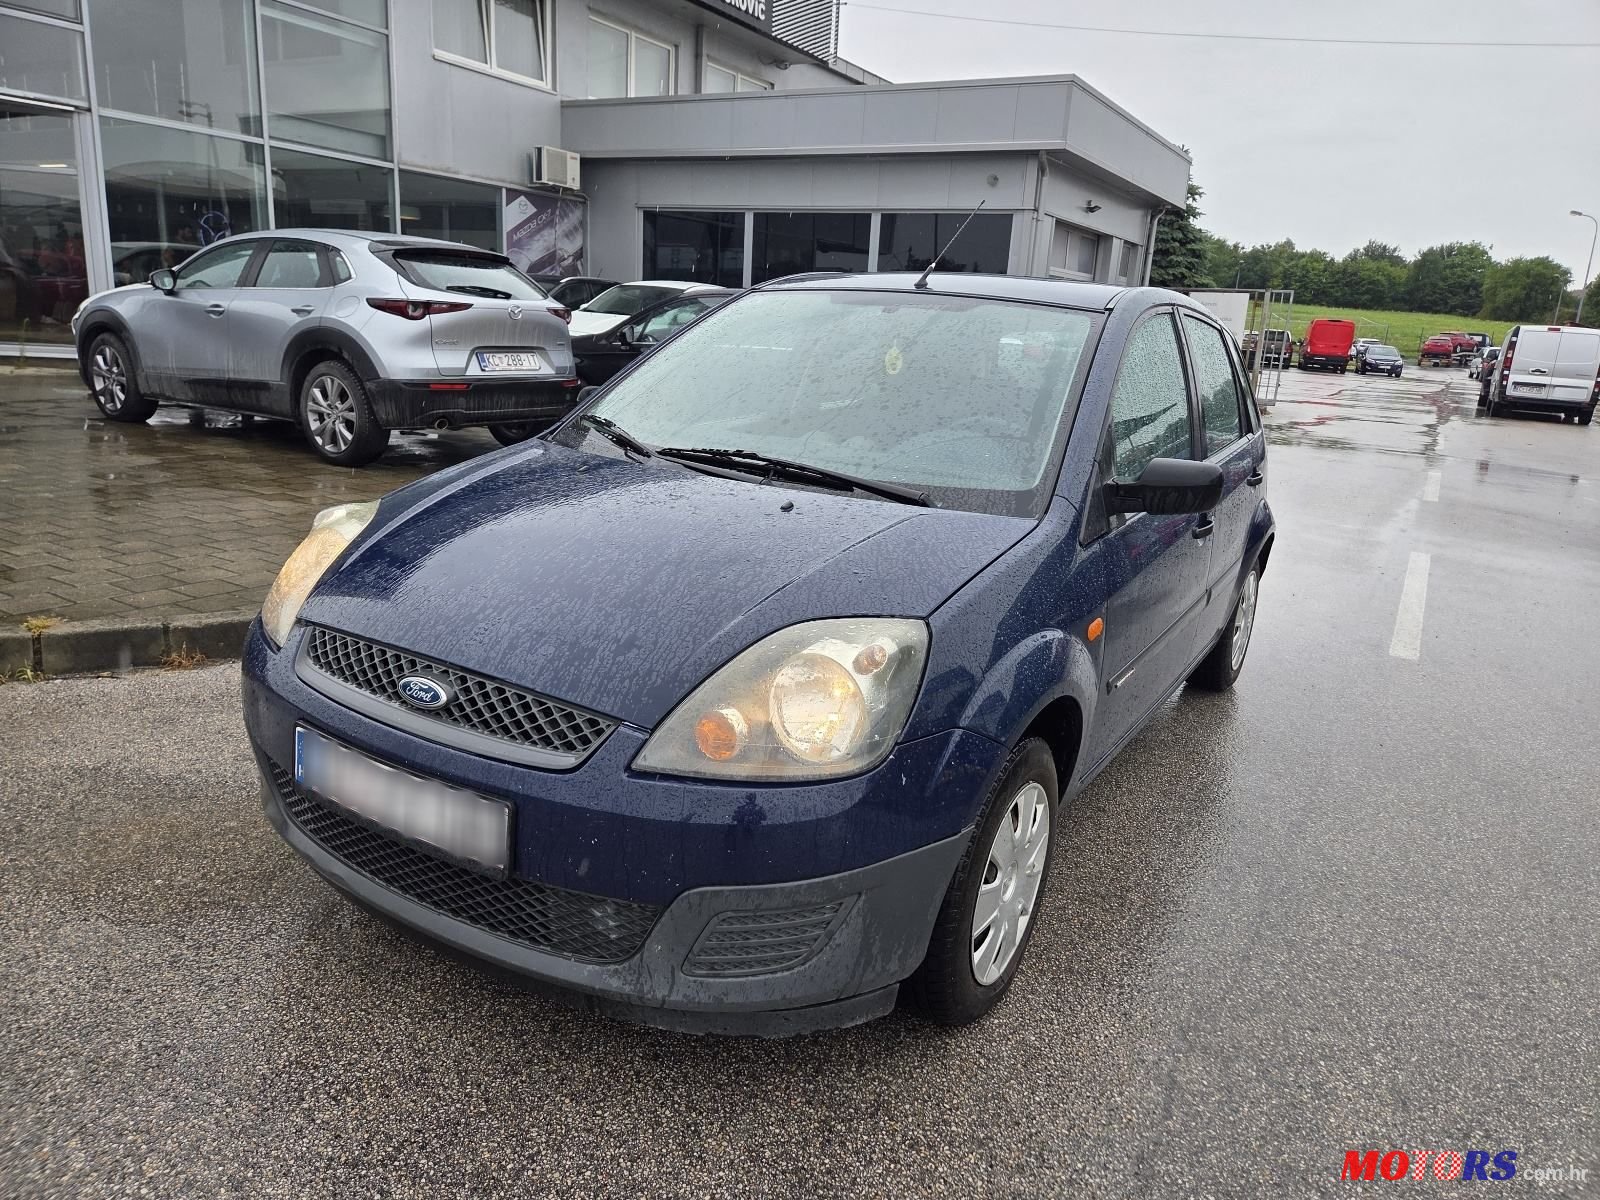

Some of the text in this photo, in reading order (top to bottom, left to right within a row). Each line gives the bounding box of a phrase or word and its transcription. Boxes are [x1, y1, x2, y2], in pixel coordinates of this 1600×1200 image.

[486, 354, 538, 367] KC 288-IT
[406, 681, 434, 701] Ford
